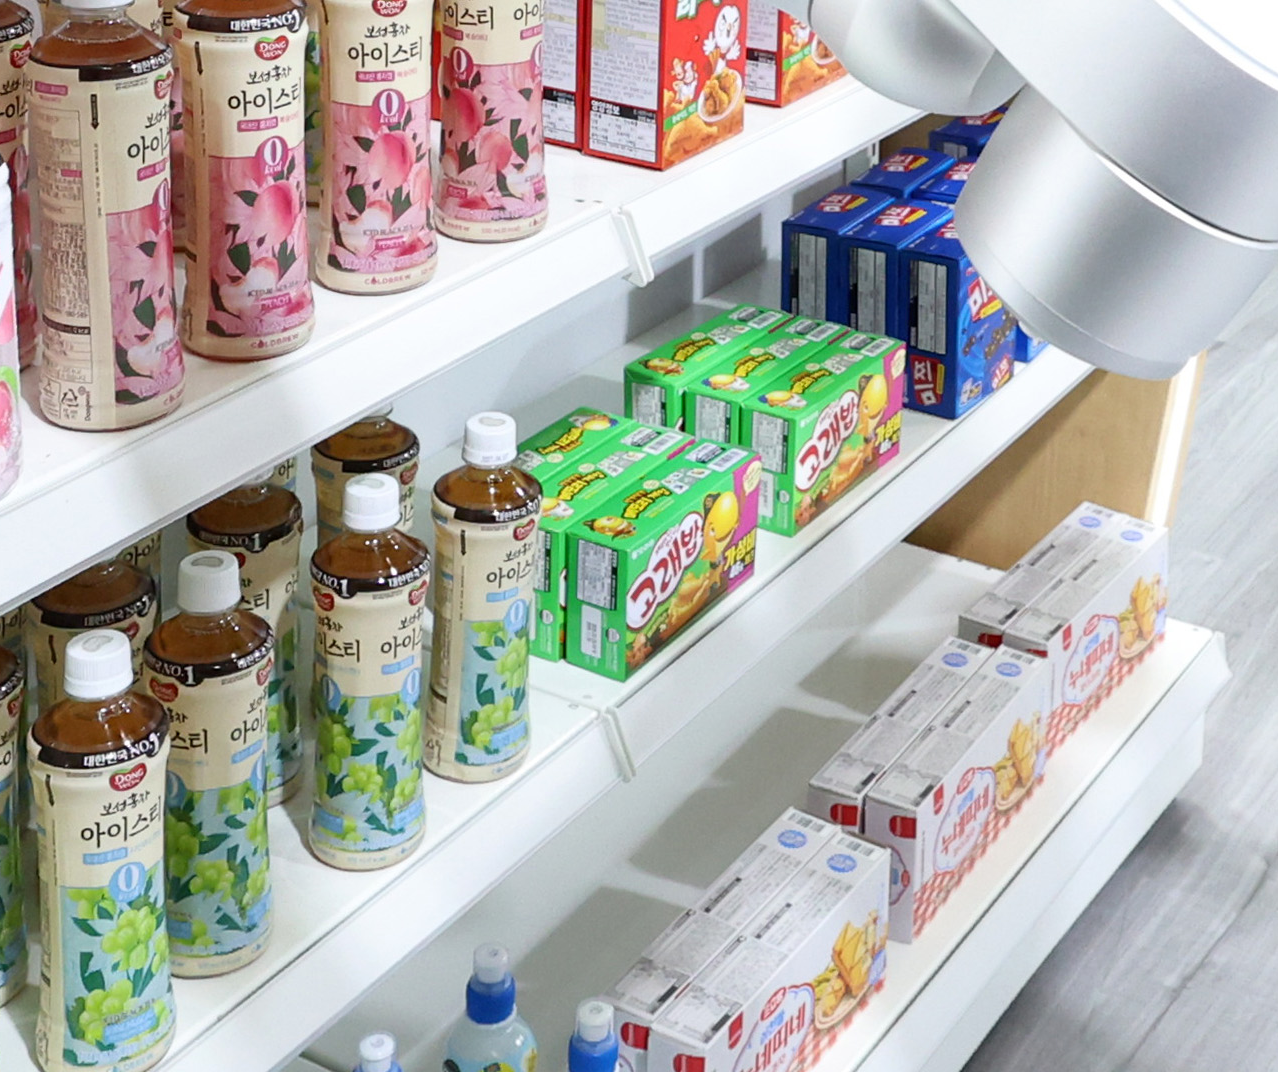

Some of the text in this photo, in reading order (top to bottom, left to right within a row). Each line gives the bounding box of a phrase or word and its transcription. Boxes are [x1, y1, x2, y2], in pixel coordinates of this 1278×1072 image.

[379, 6, 402, 16] WON
[230, 16, 273, 32] 대한민국
[364, 22, 411, 39] 보성홍차
[259, 41, 287, 54] DONG
[263, 49, 284, 59] WON
[348, 37, 424, 69] 아이스티
[246, 65, 292, 85] 보성홍차
[228, 77, 301, 118] 아이스티
[379, 91, 401, 118] 0
[379, 114, 400, 125] kcal
[263, 139, 283, 166] 0
[264, 164, 283, 175] kcal
[913, 359, 938, 406] 미쯔
[800, 396, 860, 482] 고래밥
[495, 507, 529, 523] 대한민국
[388, 568, 421, 588] 대한민국
[631, 520, 704, 618] 고래밥
[162, 662, 197, 686] NO.1
[83, 732, 161, 768] 대한민국 NO.1
[114, 768, 145, 784] DONG
[100, 790, 151, 817] 보성홍차
[81, 796, 163, 849] 아이스티
[118, 866, 139, 893] 0
